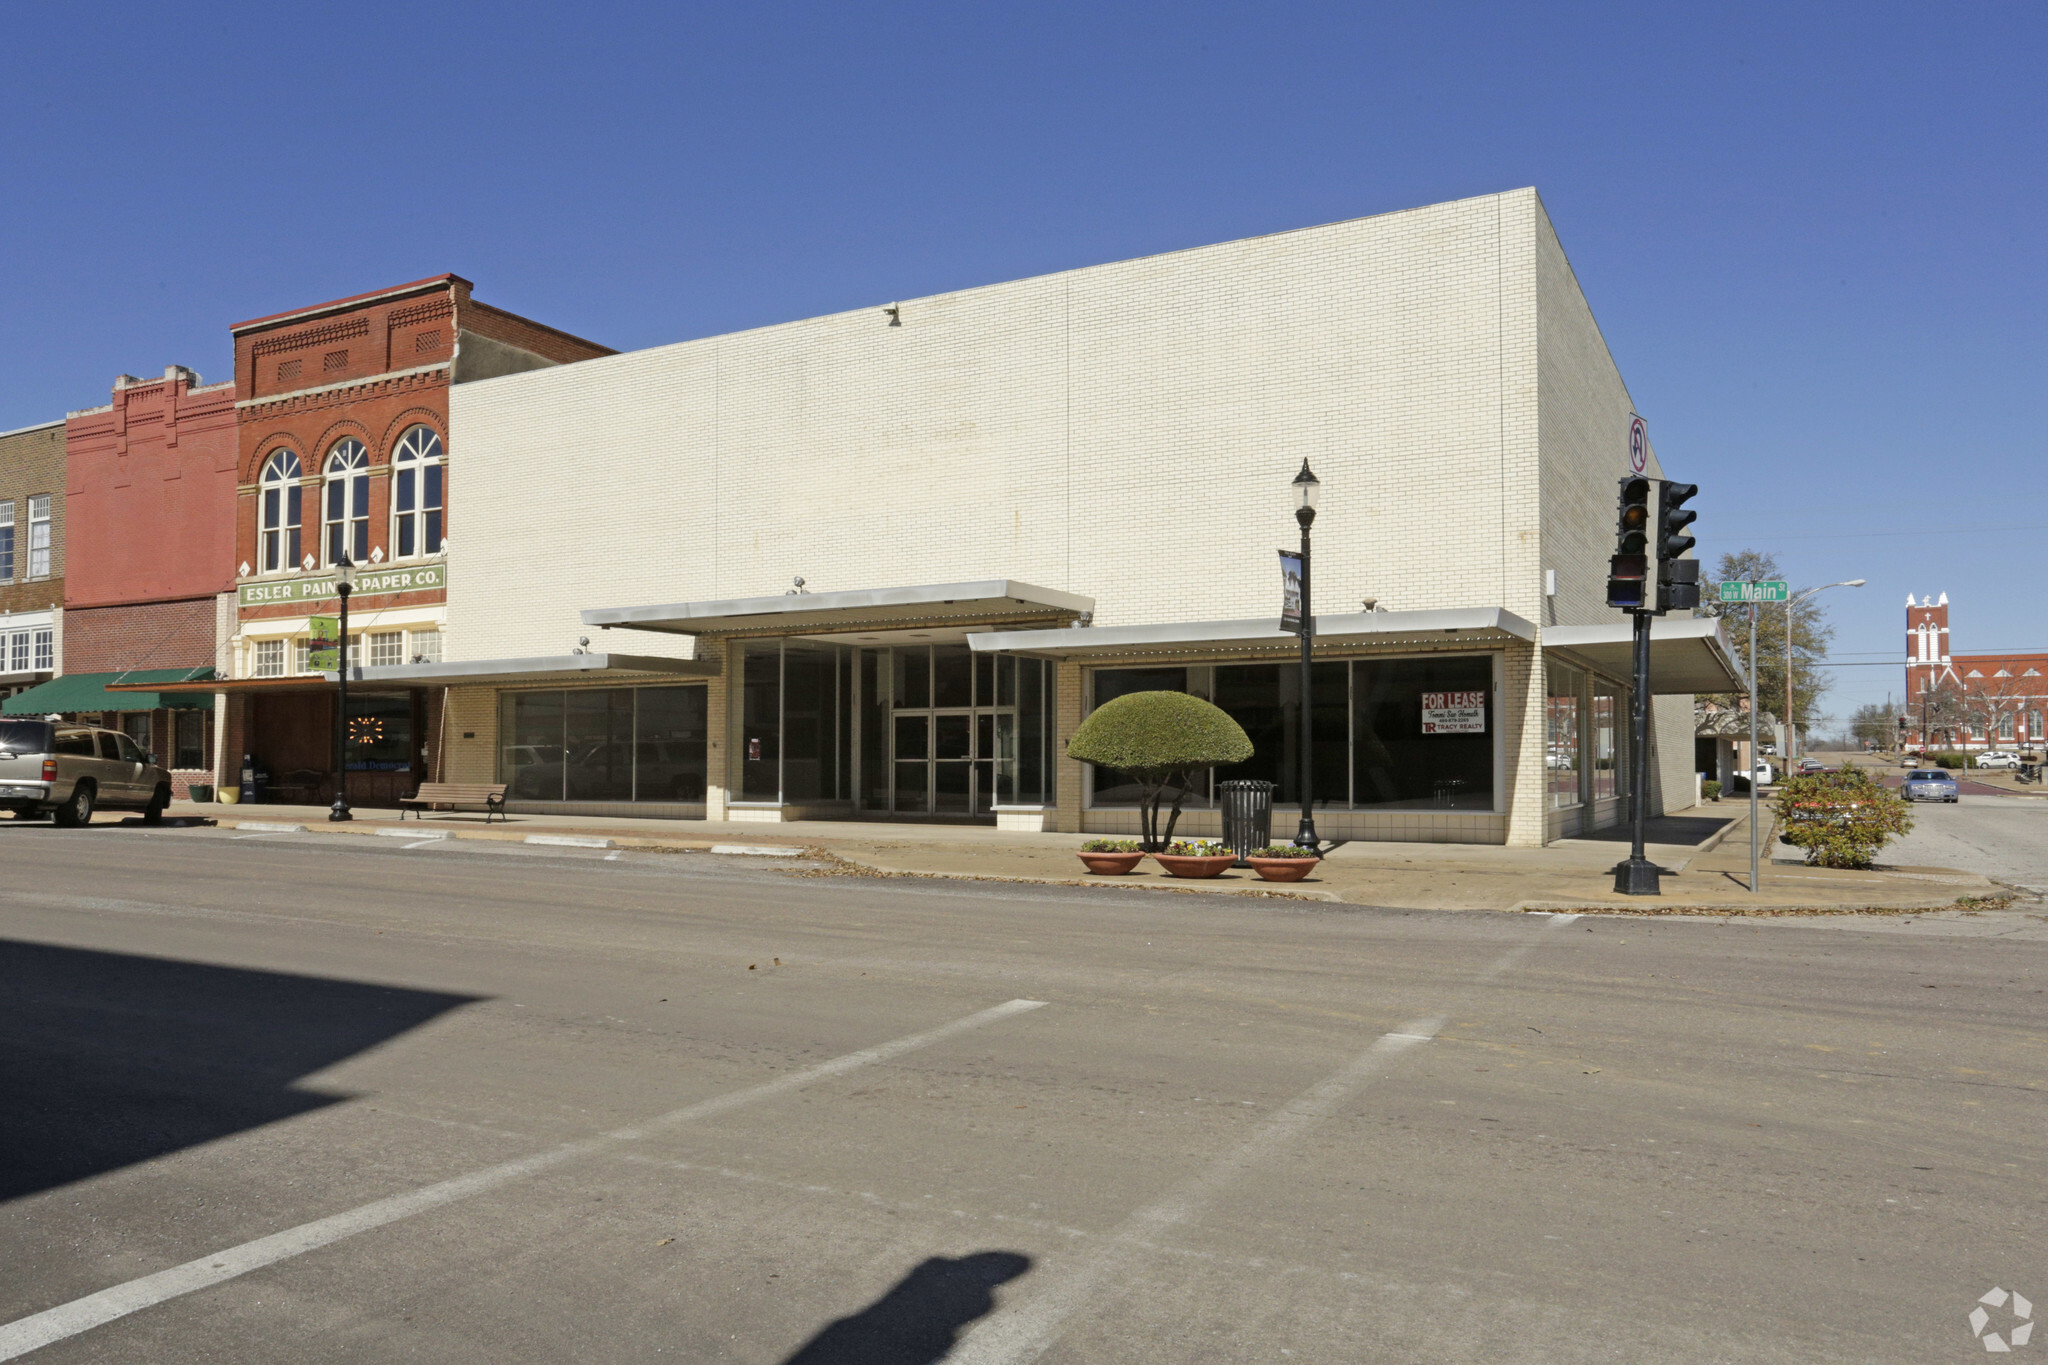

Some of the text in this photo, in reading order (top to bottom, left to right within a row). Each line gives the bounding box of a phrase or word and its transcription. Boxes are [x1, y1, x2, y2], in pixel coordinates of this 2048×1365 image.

[246, 585, 292, 601] ESLER
[302, 581, 339, 597] PAIN
[362, 573, 411, 591] PAPER
[415, 570, 439, 585] CO.
[1733, 591, 1739, 599] W
[1740, 583, 1776, 600] Main
[1778, 583, 1786, 591] St
[1422, 692, 1484, 709] FOR LEASE
[345, 761, 367, 770] erald
